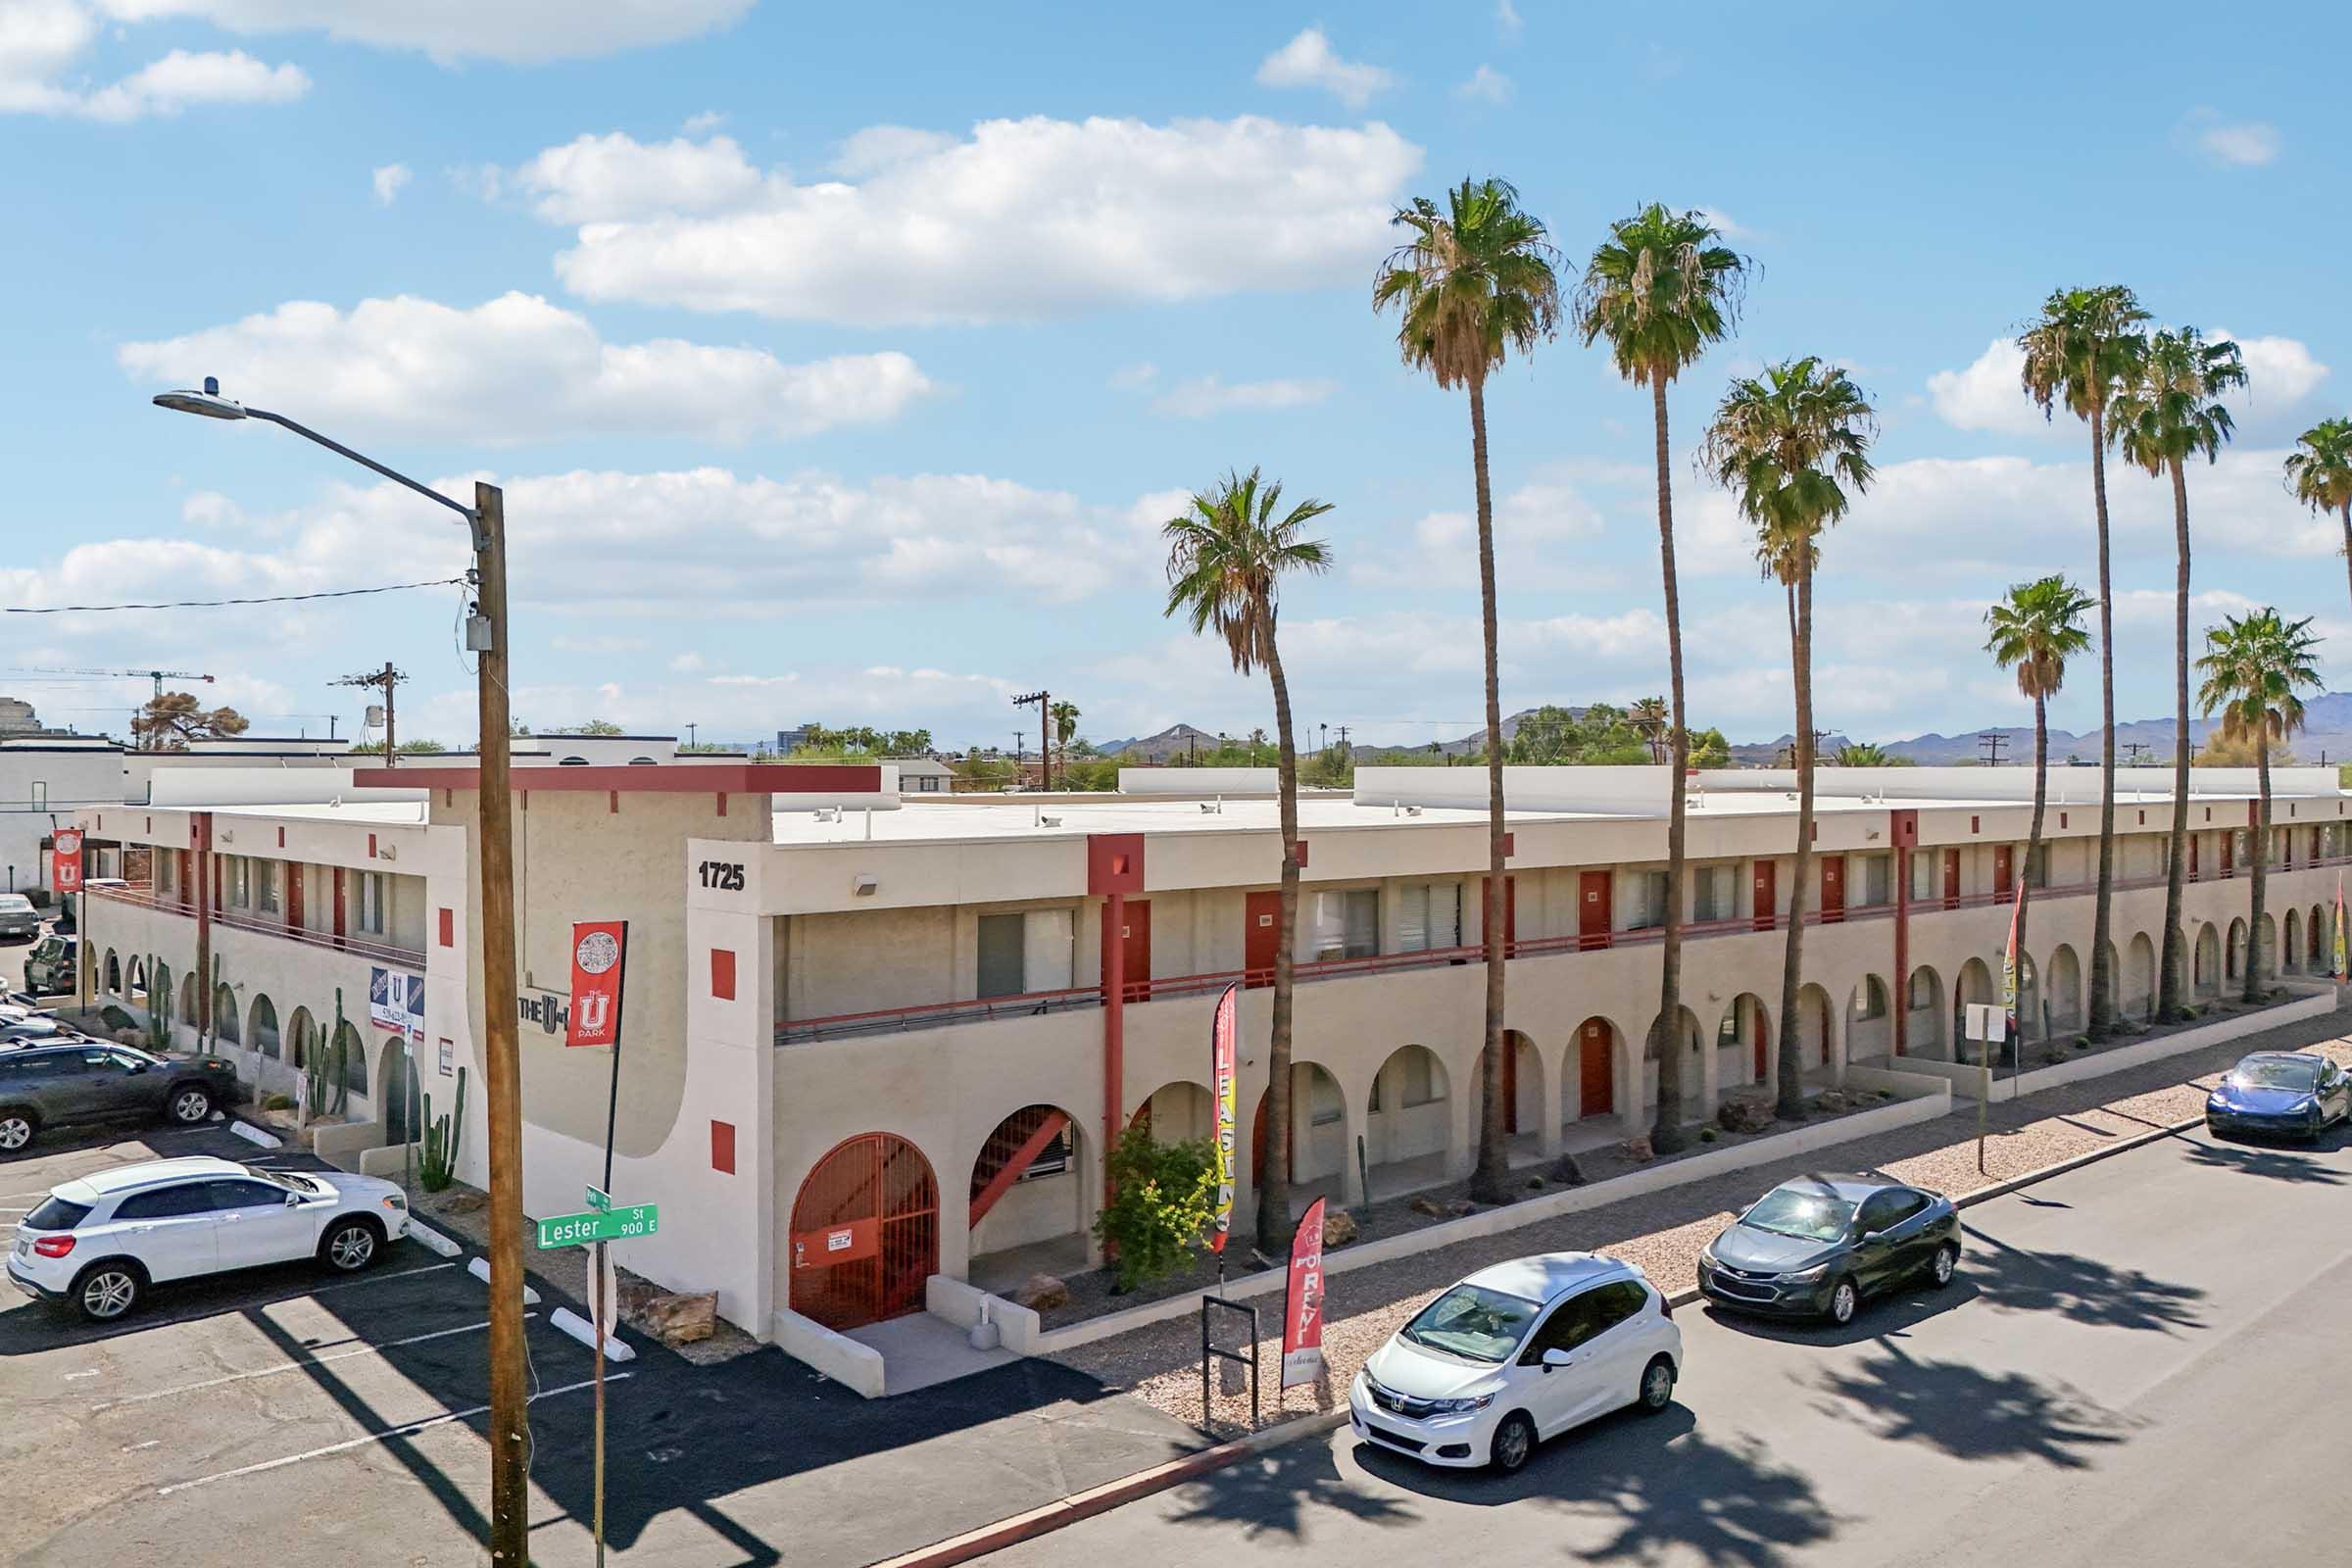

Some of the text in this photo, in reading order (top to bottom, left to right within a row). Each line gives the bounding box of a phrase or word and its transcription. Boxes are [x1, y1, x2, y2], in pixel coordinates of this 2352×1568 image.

[699, 860, 745, 891] 1725
[517, 997, 542, 1023] THE
[542, 995, 557, 1034] U
[580, 995, 610, 1029] U
[578, 1028, 606, 1039] PARK
[1216, 1048, 1235, 1232] LEASING
[541, 1208, 643, 1246] Lester St
[621, 1220, 656, 1235] 900 E
